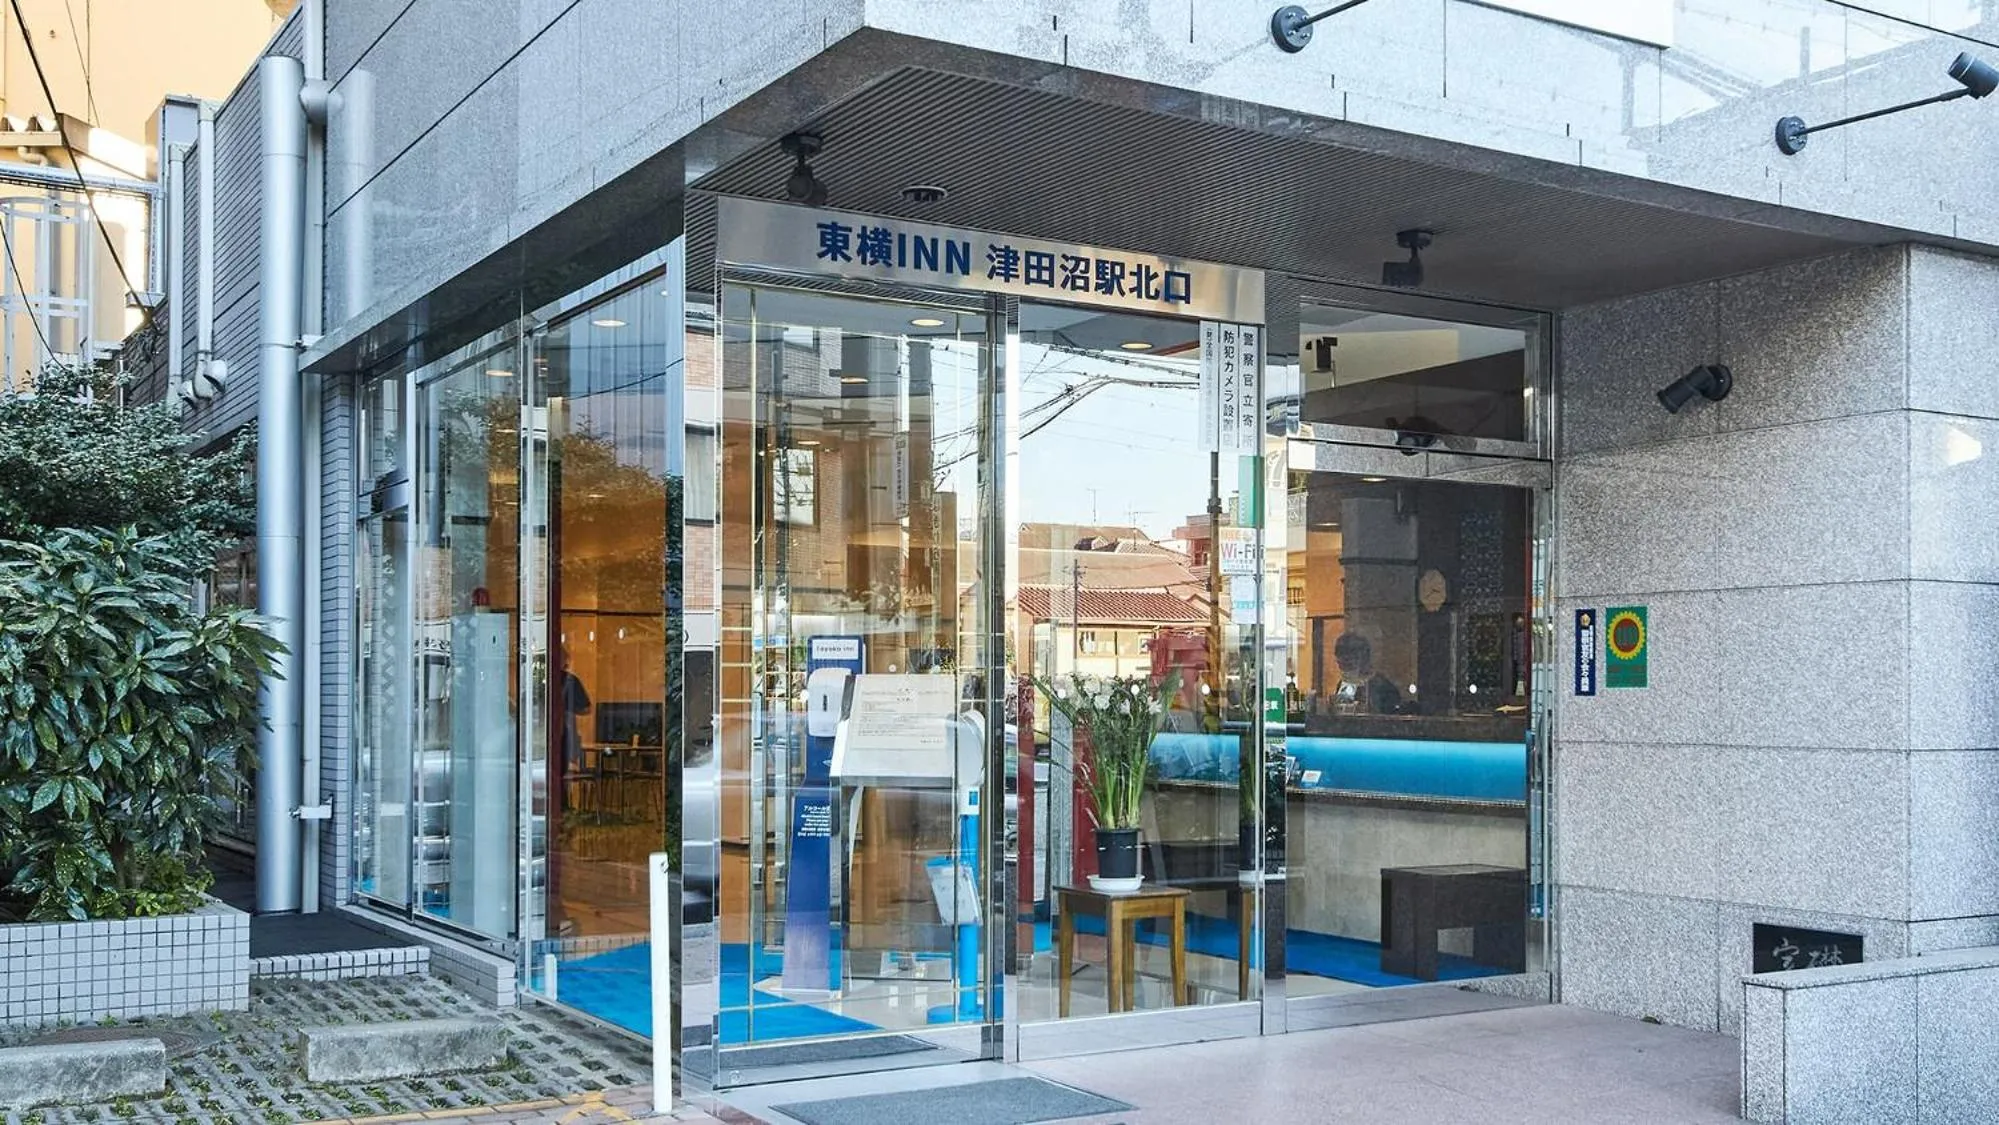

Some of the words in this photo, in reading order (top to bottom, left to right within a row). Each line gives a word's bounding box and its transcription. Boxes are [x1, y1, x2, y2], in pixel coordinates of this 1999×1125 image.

[815, 221, 972, 276] 東横INN
[985, 243, 1193, 306] 津田沼駅北口
[1242, 332, 1254, 448] 警察官立寄所
[1220, 543, 1256, 560] Wi-Fi
